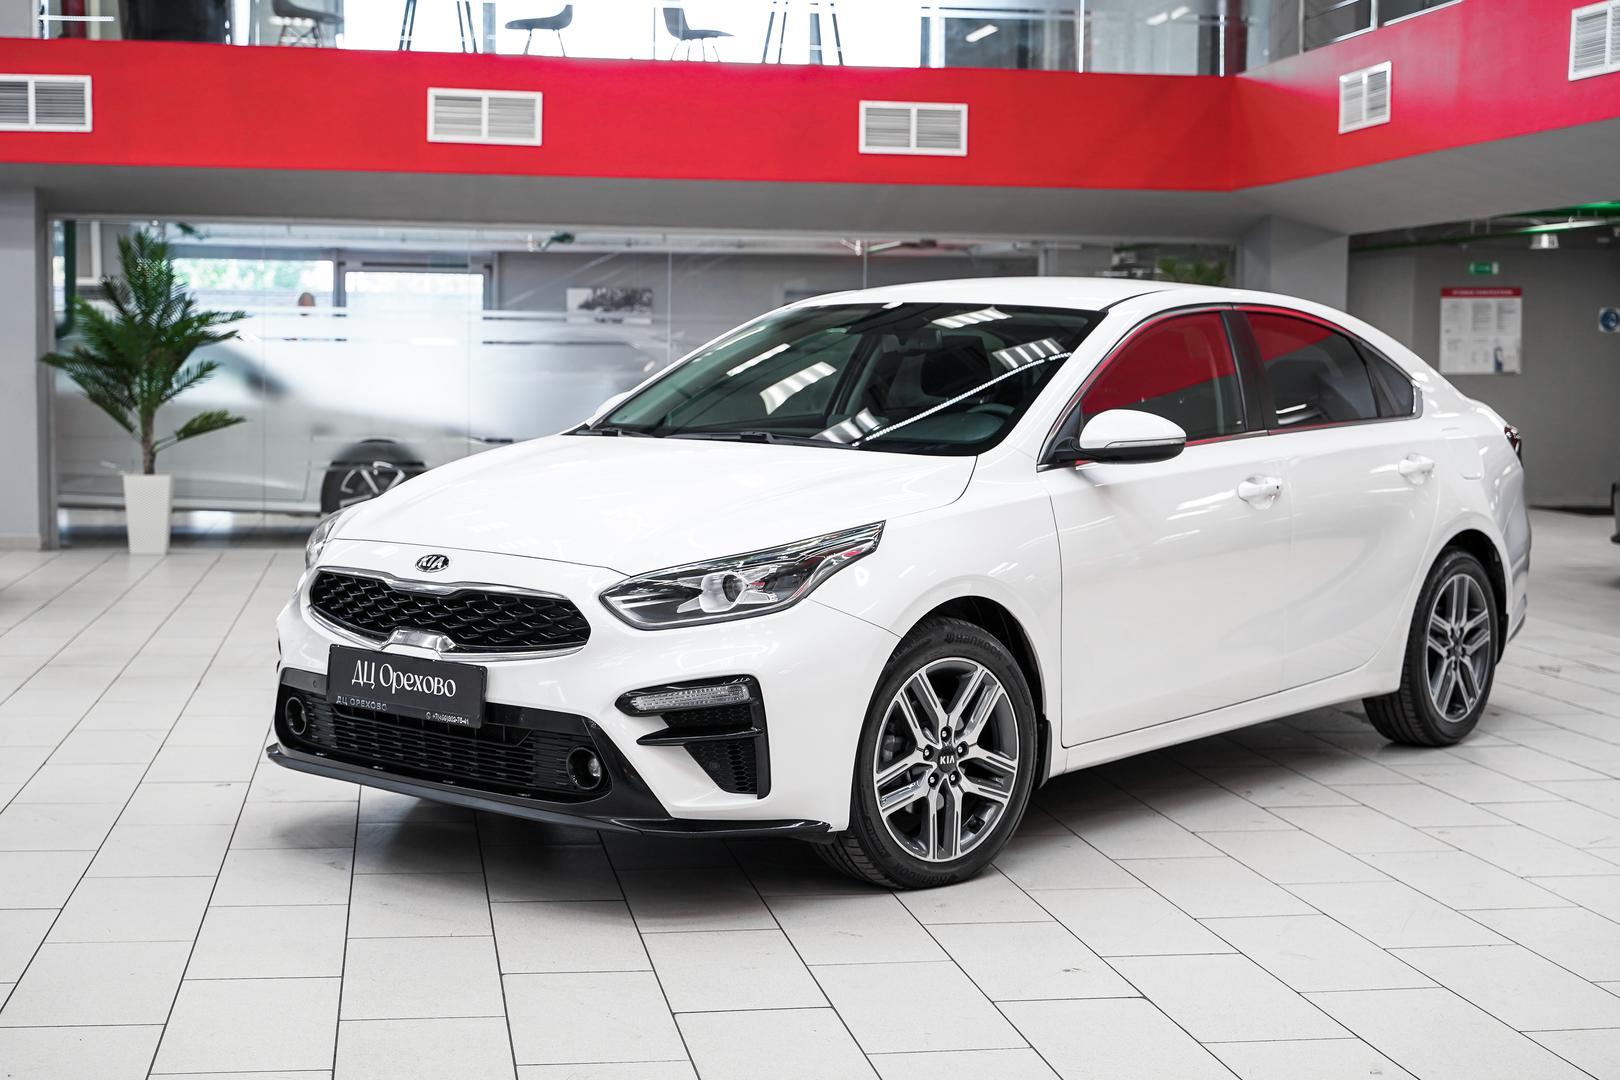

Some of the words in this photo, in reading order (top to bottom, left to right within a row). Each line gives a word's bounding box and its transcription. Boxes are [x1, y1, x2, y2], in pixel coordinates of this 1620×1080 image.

[417, 555, 447, 570] KIA
[351, 659, 376, 690] ДЦ
[379, 663, 457, 698] Орехово
[350, 697, 388, 712] ОРЕХОВО
[940, 755, 955, 765] KIA
